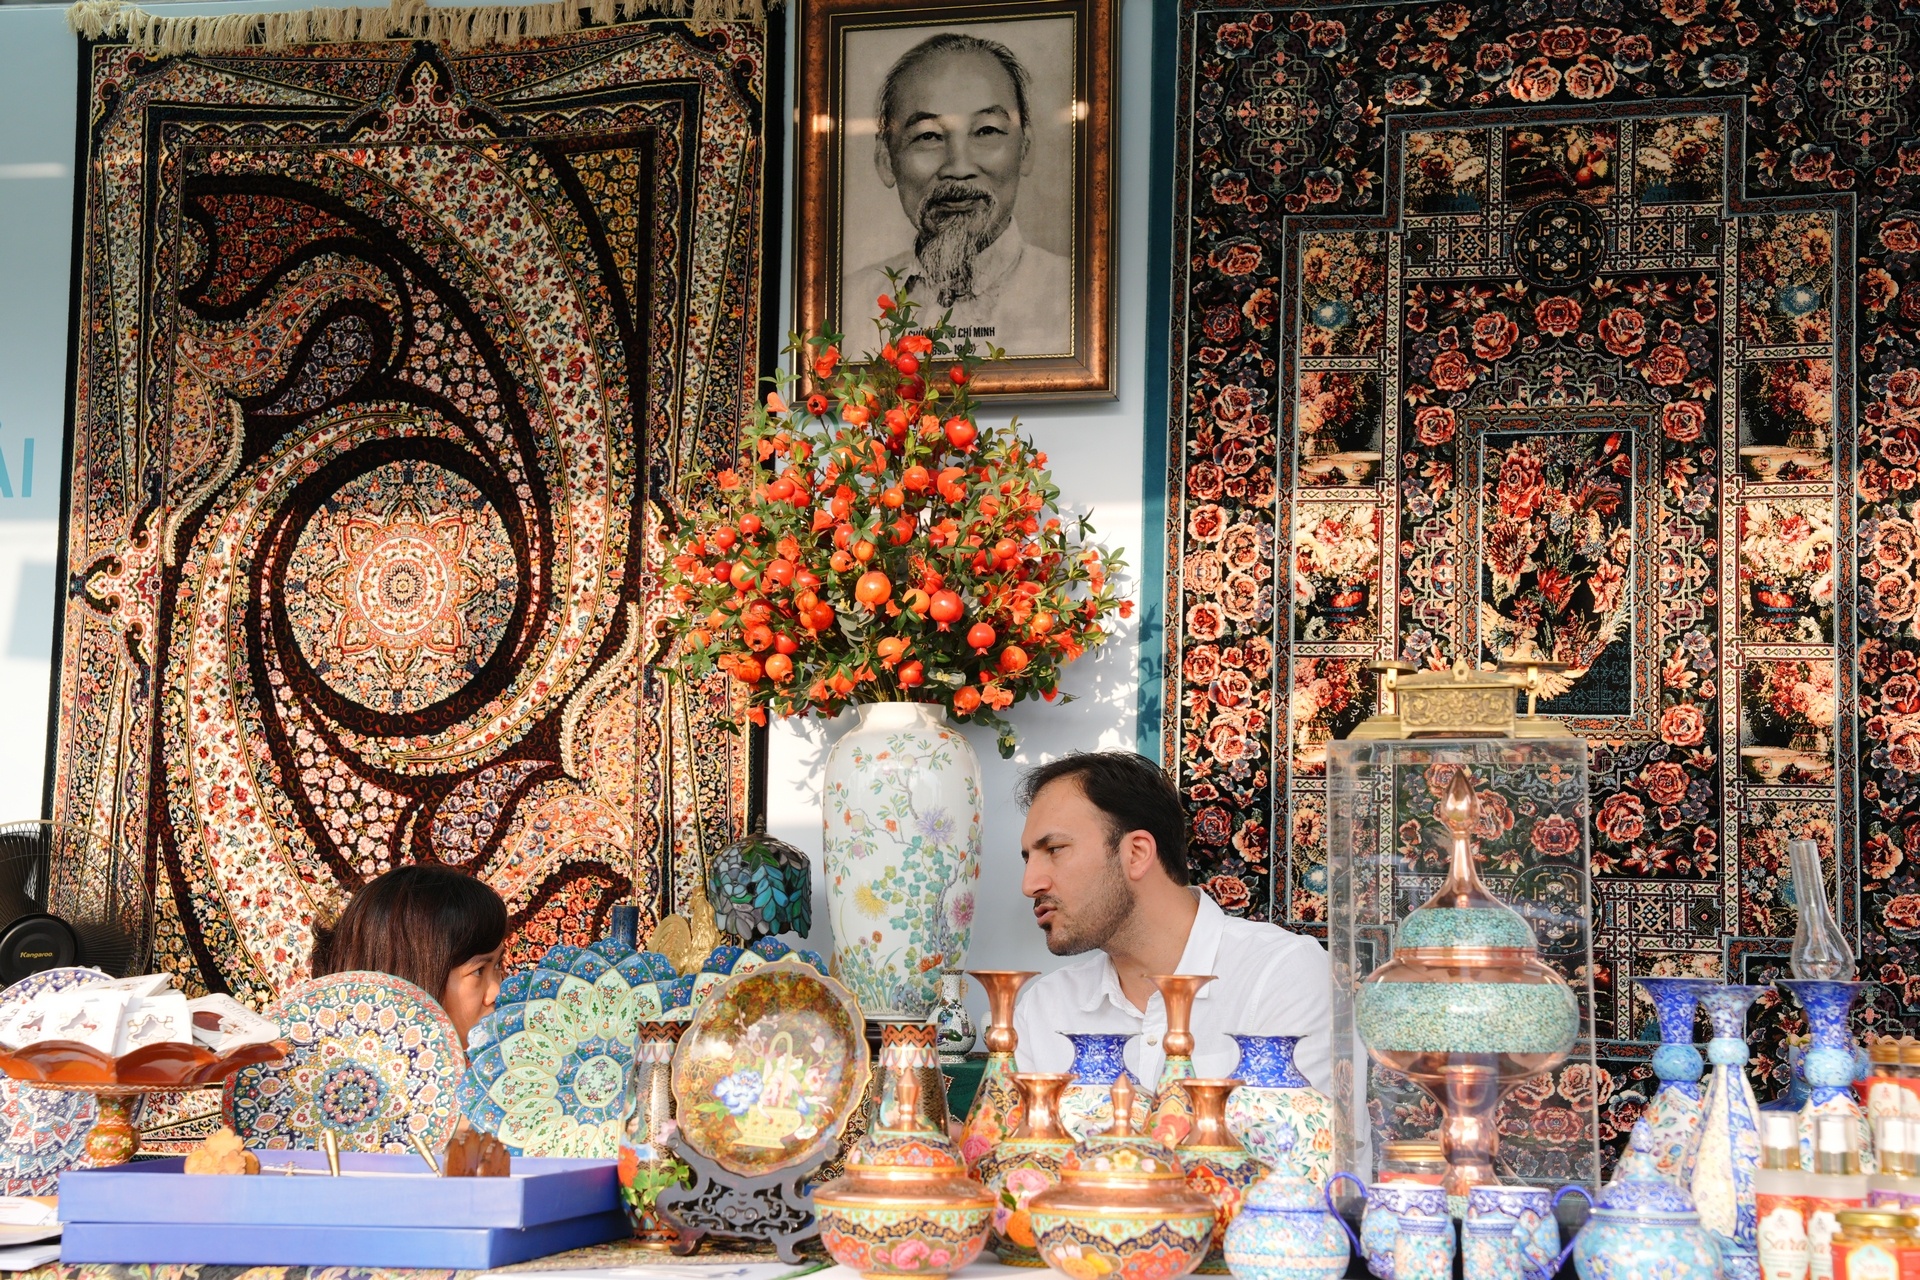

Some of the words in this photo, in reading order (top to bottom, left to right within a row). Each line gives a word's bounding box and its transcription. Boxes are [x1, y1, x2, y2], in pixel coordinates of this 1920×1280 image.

[958, 325, 972, 338] CHÍ
[973, 326, 995, 337] MINH
[20, 951, 53, 959] Kangaroo
[1762, 1231, 1808, 1251] Sara
